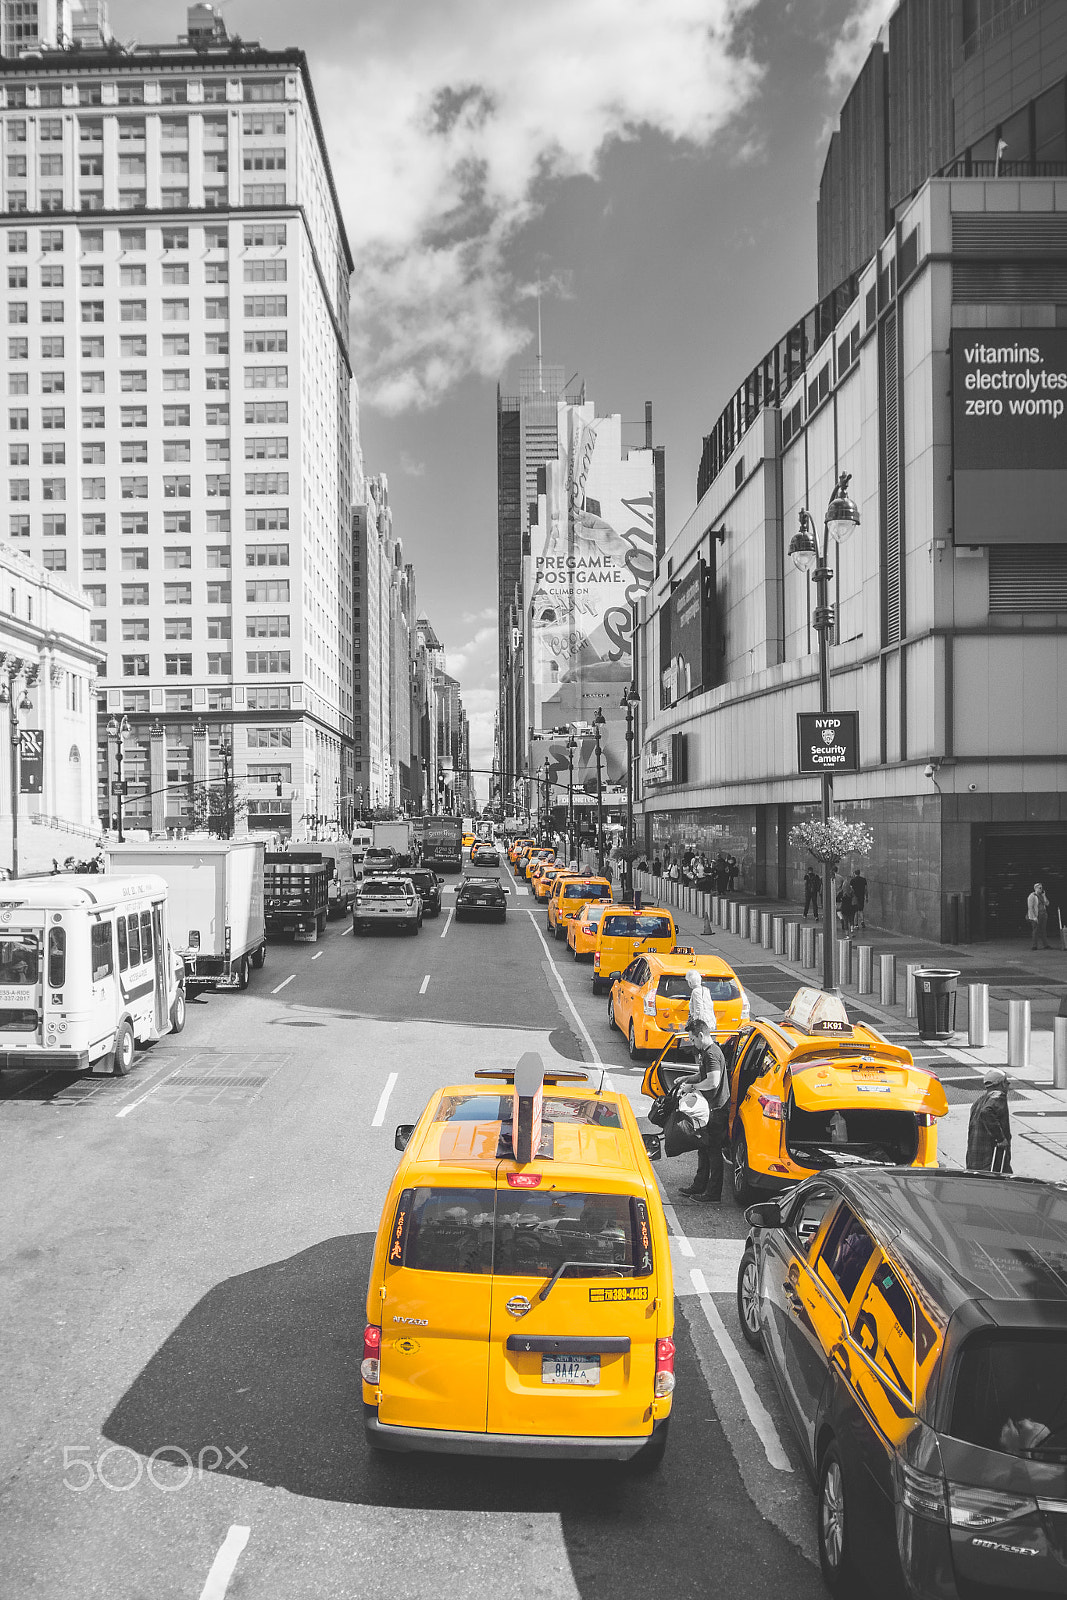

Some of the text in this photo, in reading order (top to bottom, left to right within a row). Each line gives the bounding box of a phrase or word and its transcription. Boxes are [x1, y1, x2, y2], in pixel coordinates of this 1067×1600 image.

[964, 342, 1044, 363] vitamins.
[965, 368, 1067, 393] electrolytes
[965, 399, 1064, 419] zero womp
[535, 556, 616, 569] PREGAME.
[535, 571, 626, 584] POSTGAME.
[815, 719, 841, 728] NYPD
[811, 745, 846, 756] Security
[812, 754, 846, 763] Camera
[823, 1021, 842, 1030] 1K91
[555, 1363, 579, 1378] 8A42
